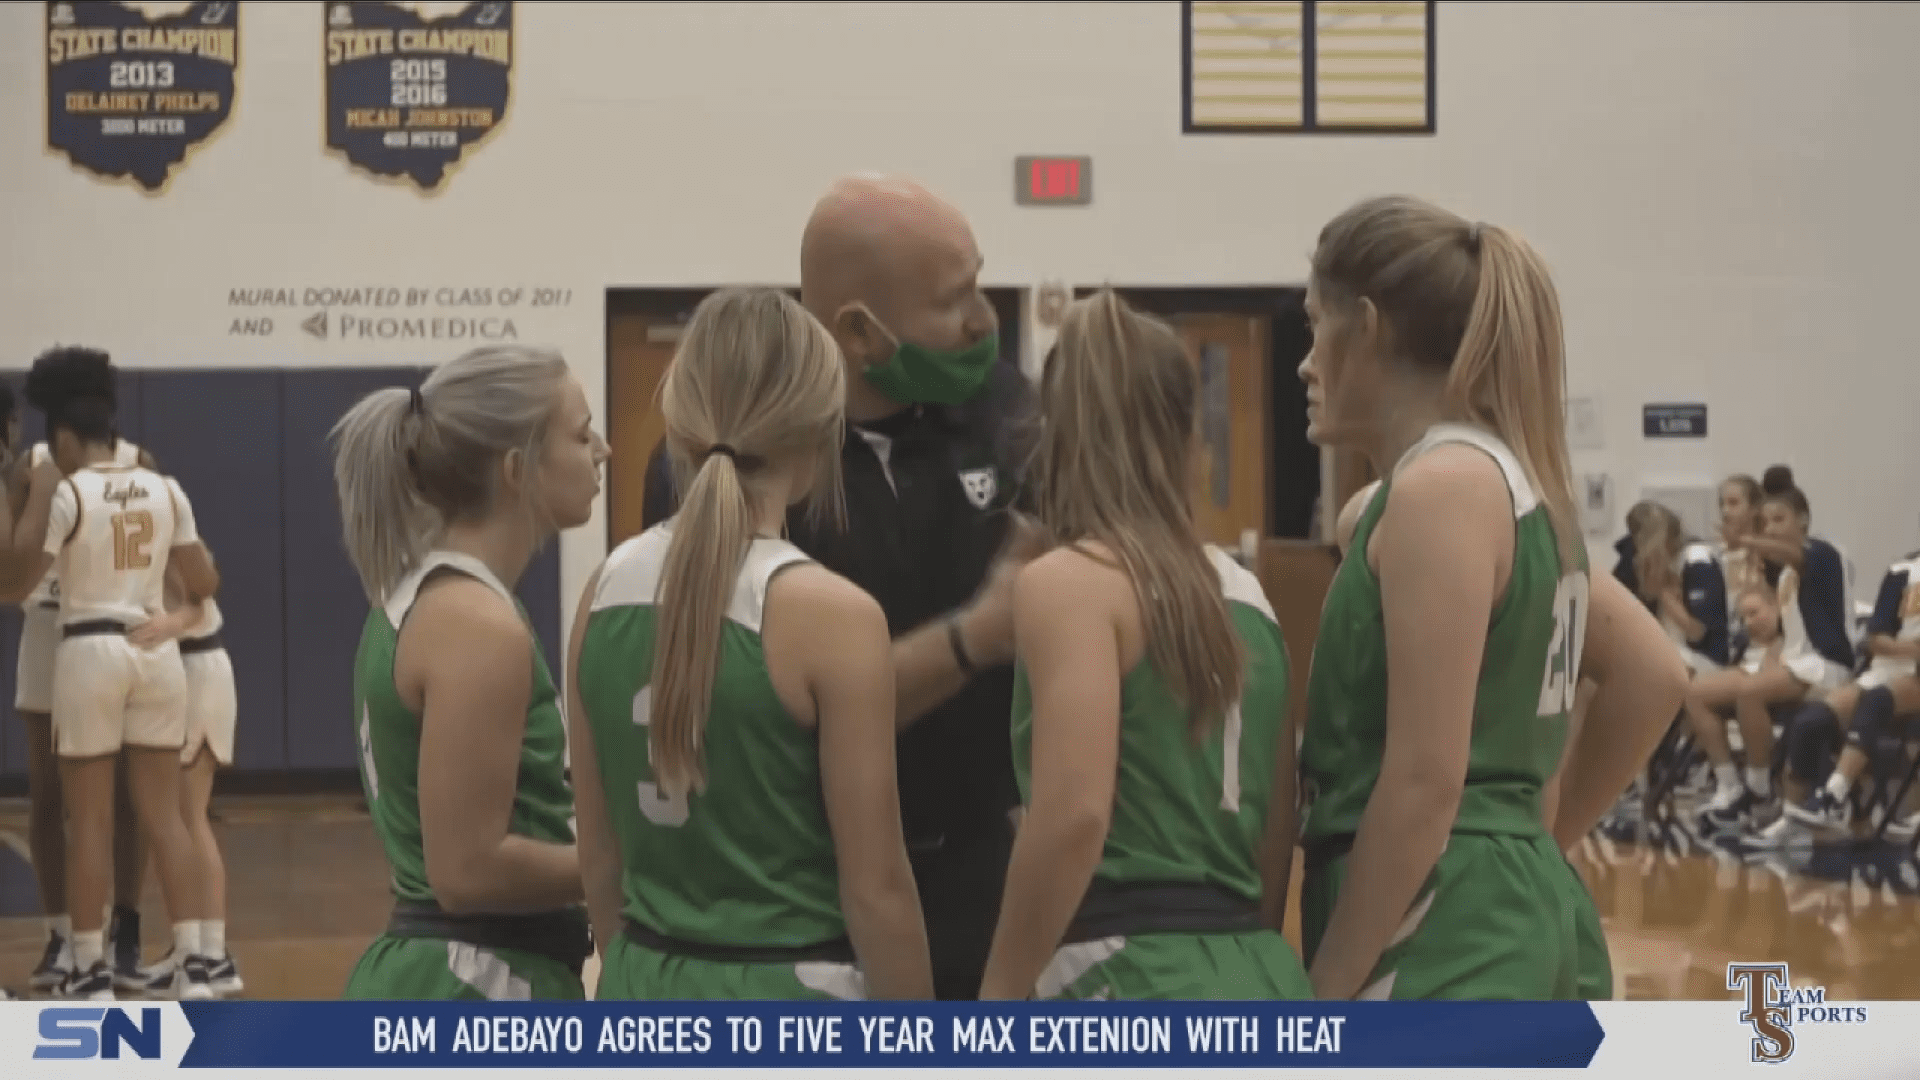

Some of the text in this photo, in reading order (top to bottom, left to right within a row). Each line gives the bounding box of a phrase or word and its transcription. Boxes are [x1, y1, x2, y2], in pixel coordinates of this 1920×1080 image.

[50, 28, 236, 66] STATE CHAMPION
[327, 28, 510, 66] STATE CHAMPION
[110, 61, 174, 88] 2013
[390, 59, 446, 80] 2015
[155, 92, 220, 112] PHELPS
[390, 83, 447, 105] 2016
[137, 118, 186, 136] METER
[410, 131, 458, 148] METER
[1030, 159, 1080, 199] EXIT
[228, 287, 573, 307] MURAL DONATED BY CLASS OF 2011
[228, 315, 519, 340] AND PROMEDICA
[104, 480, 150, 510] Eagles
[111, 509, 154, 571] 12
[1537, 571, 1592, 718] 20
